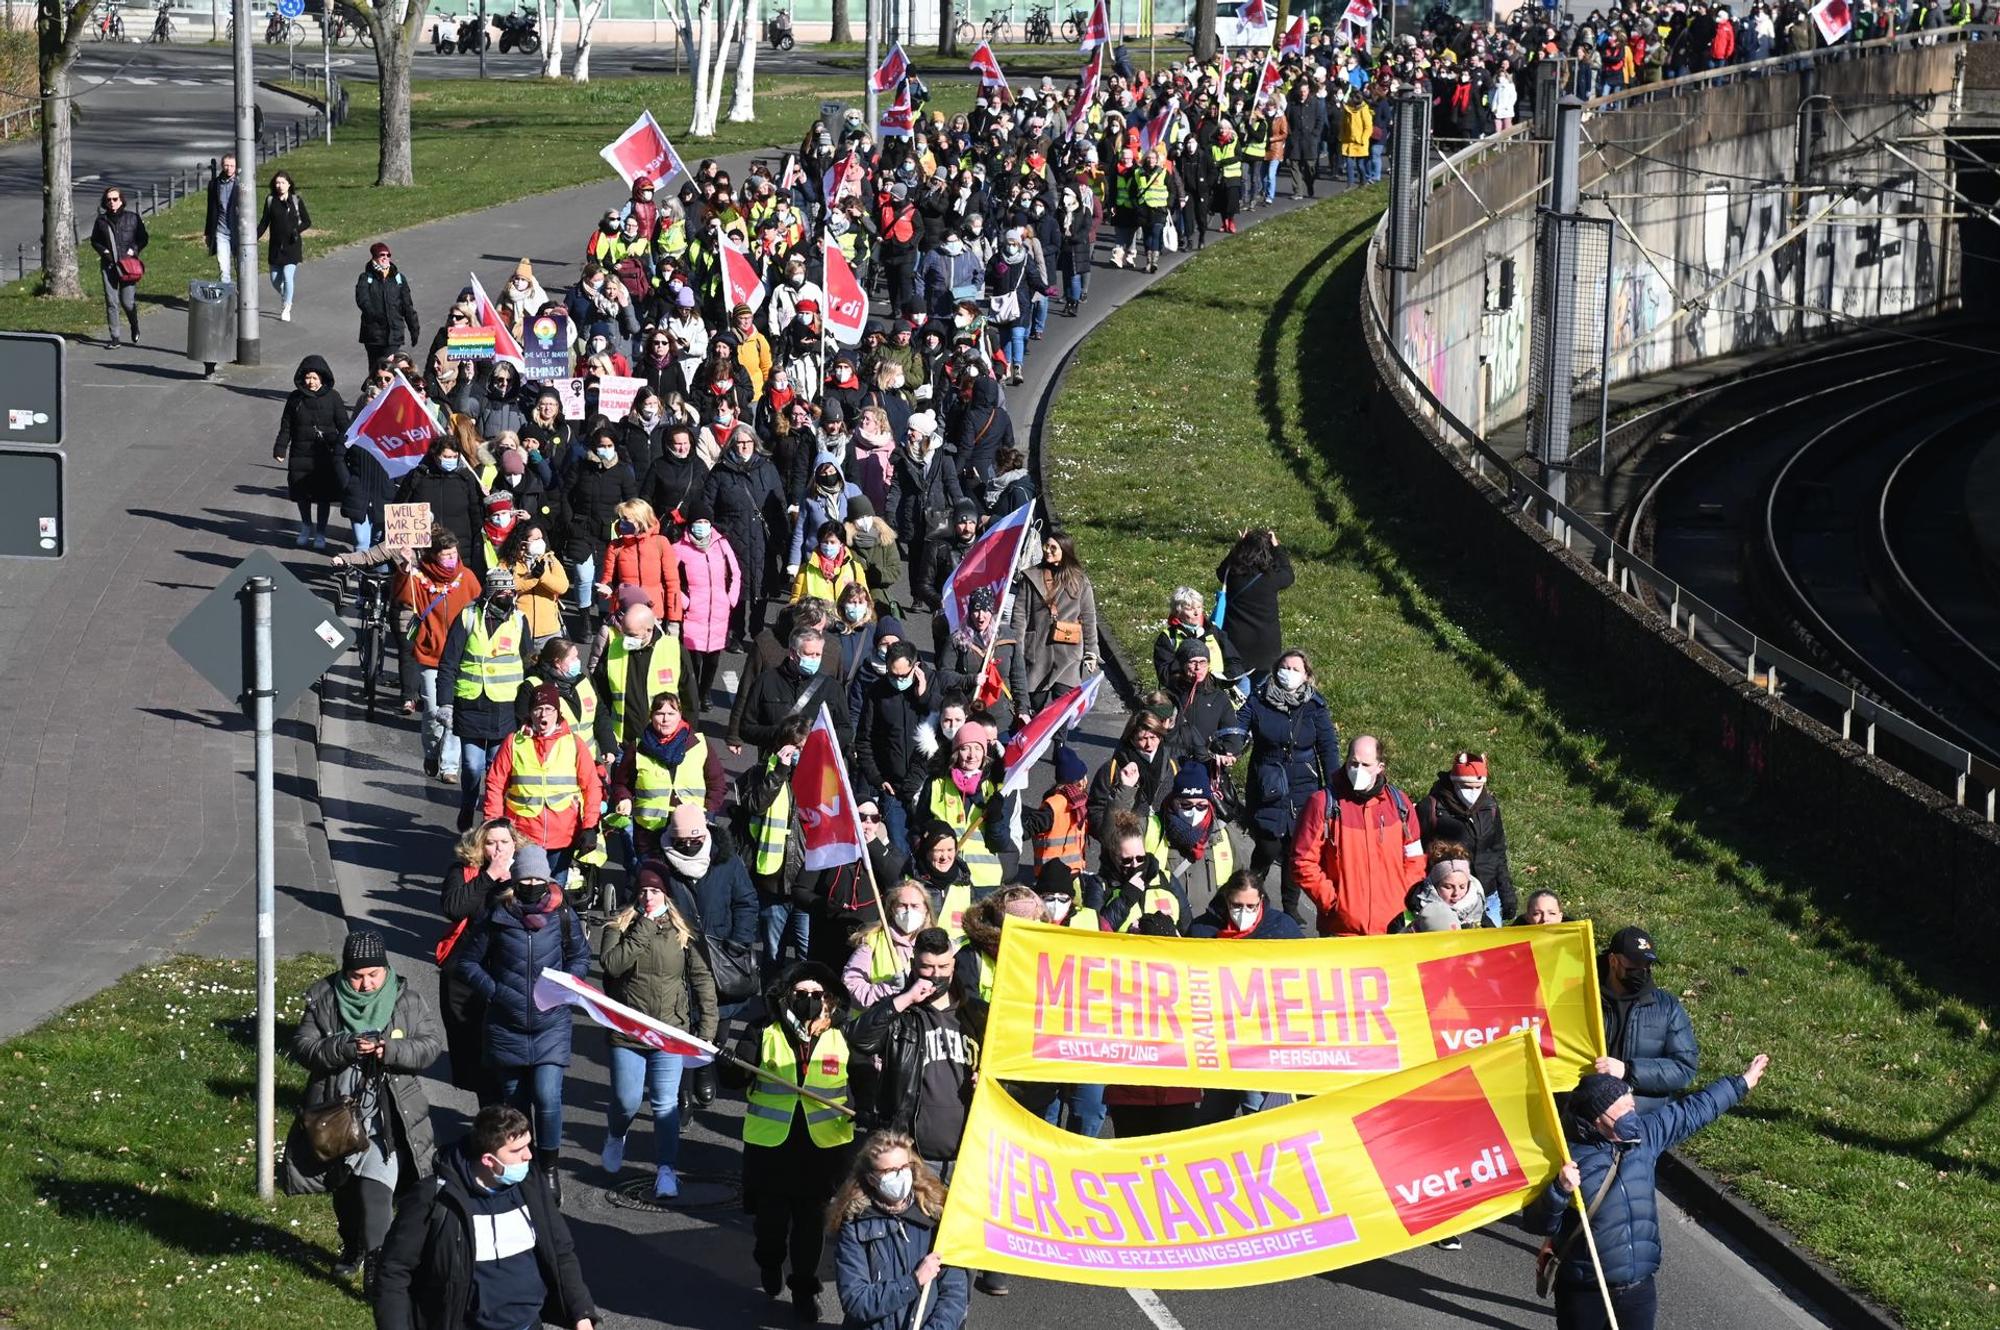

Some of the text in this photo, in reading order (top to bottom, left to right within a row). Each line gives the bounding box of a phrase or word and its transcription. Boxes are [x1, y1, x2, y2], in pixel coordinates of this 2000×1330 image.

[387, 519, 427, 530] WIR ES
[392, 506, 415, 517] WEIL
[387, 531, 430, 545] WERT SIND
[1034, 952, 1397, 1069] MEHR BRAUCHT MEHR
[1441, 1016, 1542, 1050] verdi
[1058, 1040, 1159, 1062] ENTLASTUNG
[1269, 1049, 1359, 1066] PERSONAL
[986, 1128, 1329, 1242] VER.STÄRKT
[1395, 1145, 1509, 1205] ver.di
[1007, 1228, 1318, 1266] SOZIAL- UND ERZIEHUNGSBERUFE
